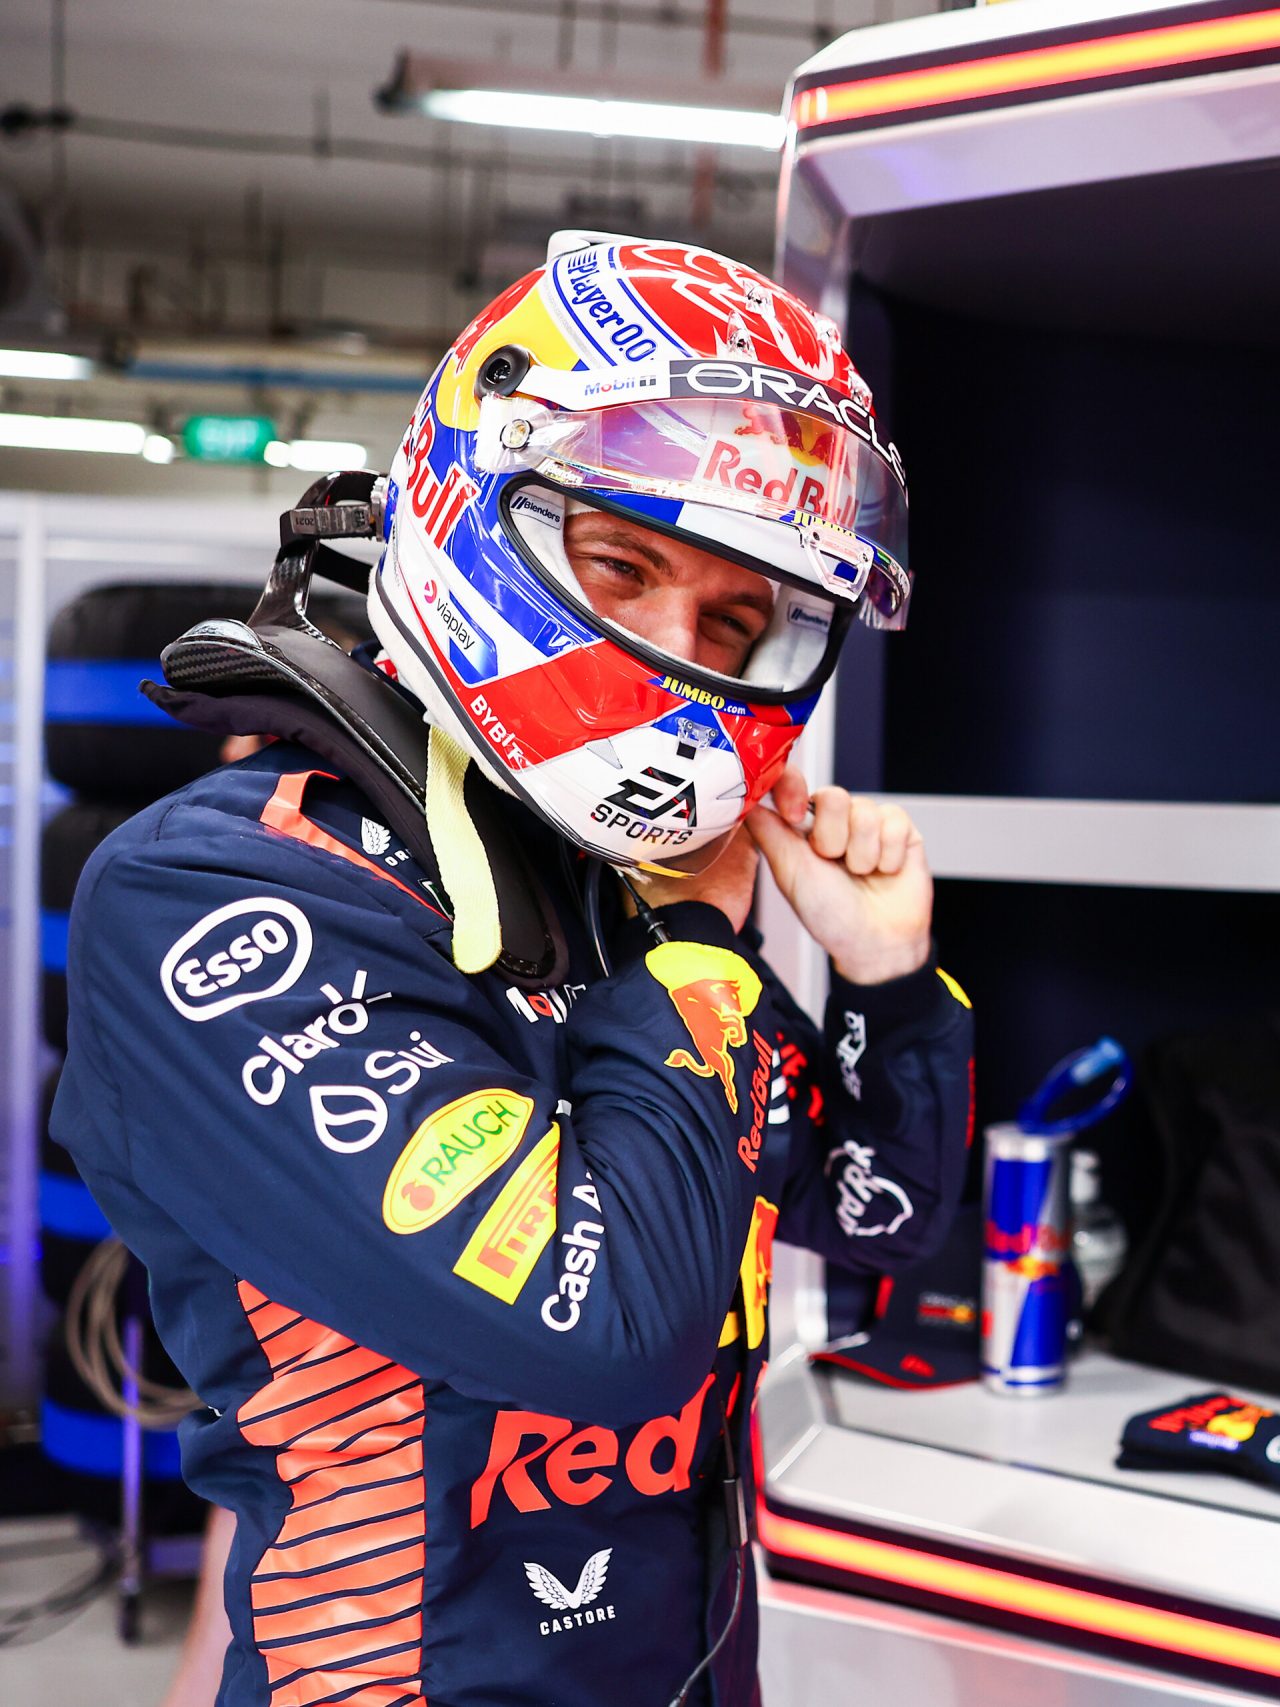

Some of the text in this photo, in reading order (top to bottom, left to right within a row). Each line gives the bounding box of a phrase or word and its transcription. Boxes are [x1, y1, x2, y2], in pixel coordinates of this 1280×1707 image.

[686, 362, 906, 488] ORACLE
[703, 439, 798, 504] Red
[523, 501, 561, 523] Blenders
[436, 597, 476, 651] viaplay
[470, 694, 524, 762] BYBIT
[590, 803, 694, 845] SPORTS
[603, 766, 697, 828] EA
[242, 1001, 369, 1106] Claro
[363, 1030, 456, 1095] Sui
[421, 1099, 520, 1187] RAUCH
[476, 1142, 558, 1279] PIRE
[541, 1169, 605, 1332] Cash A
[470, 1372, 716, 1530] Red
[539, 1604, 616, 1636] CASTORE
